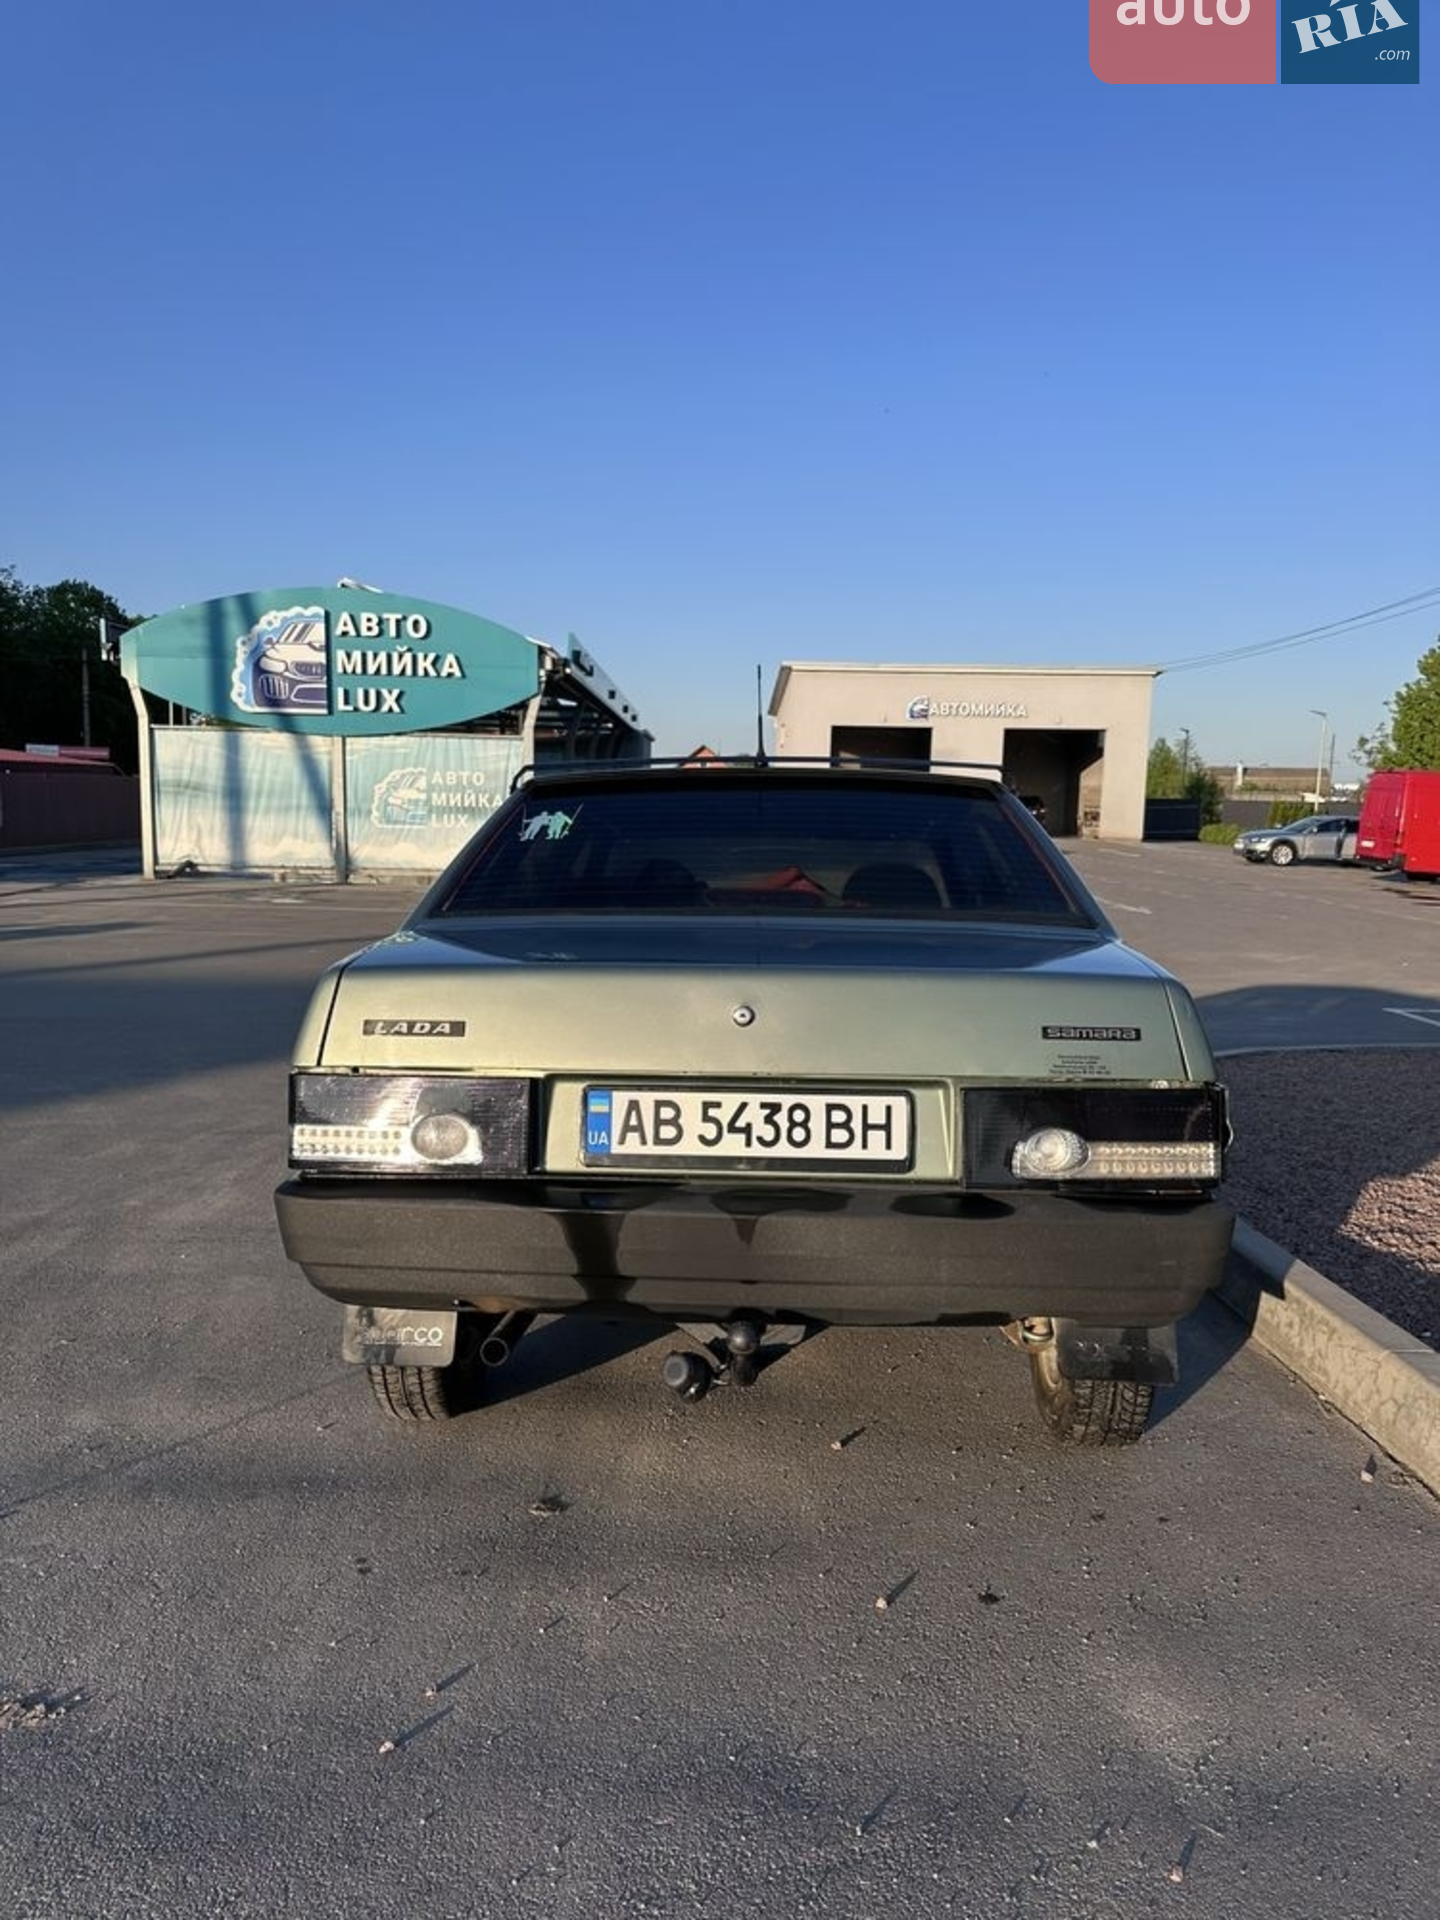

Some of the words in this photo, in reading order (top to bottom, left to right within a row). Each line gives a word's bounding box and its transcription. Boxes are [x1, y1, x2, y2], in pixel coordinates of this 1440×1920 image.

[335, 611, 429, 639] АВТО
[336, 645, 463, 678] МИЙКА
[337, 687, 402, 714] LUX
[430, 770, 485, 786] АВТО
[430, 788, 503, 807] МИЙКА
[430, 813, 469, 828] LUX
[374, 1021, 451, 1034] LADA
[617, 1099, 684, 1147] AB
[697, 1101, 811, 1148] 5438
[824, 1103, 893, 1151] BH
[588, 1131, 610, 1146] UA
